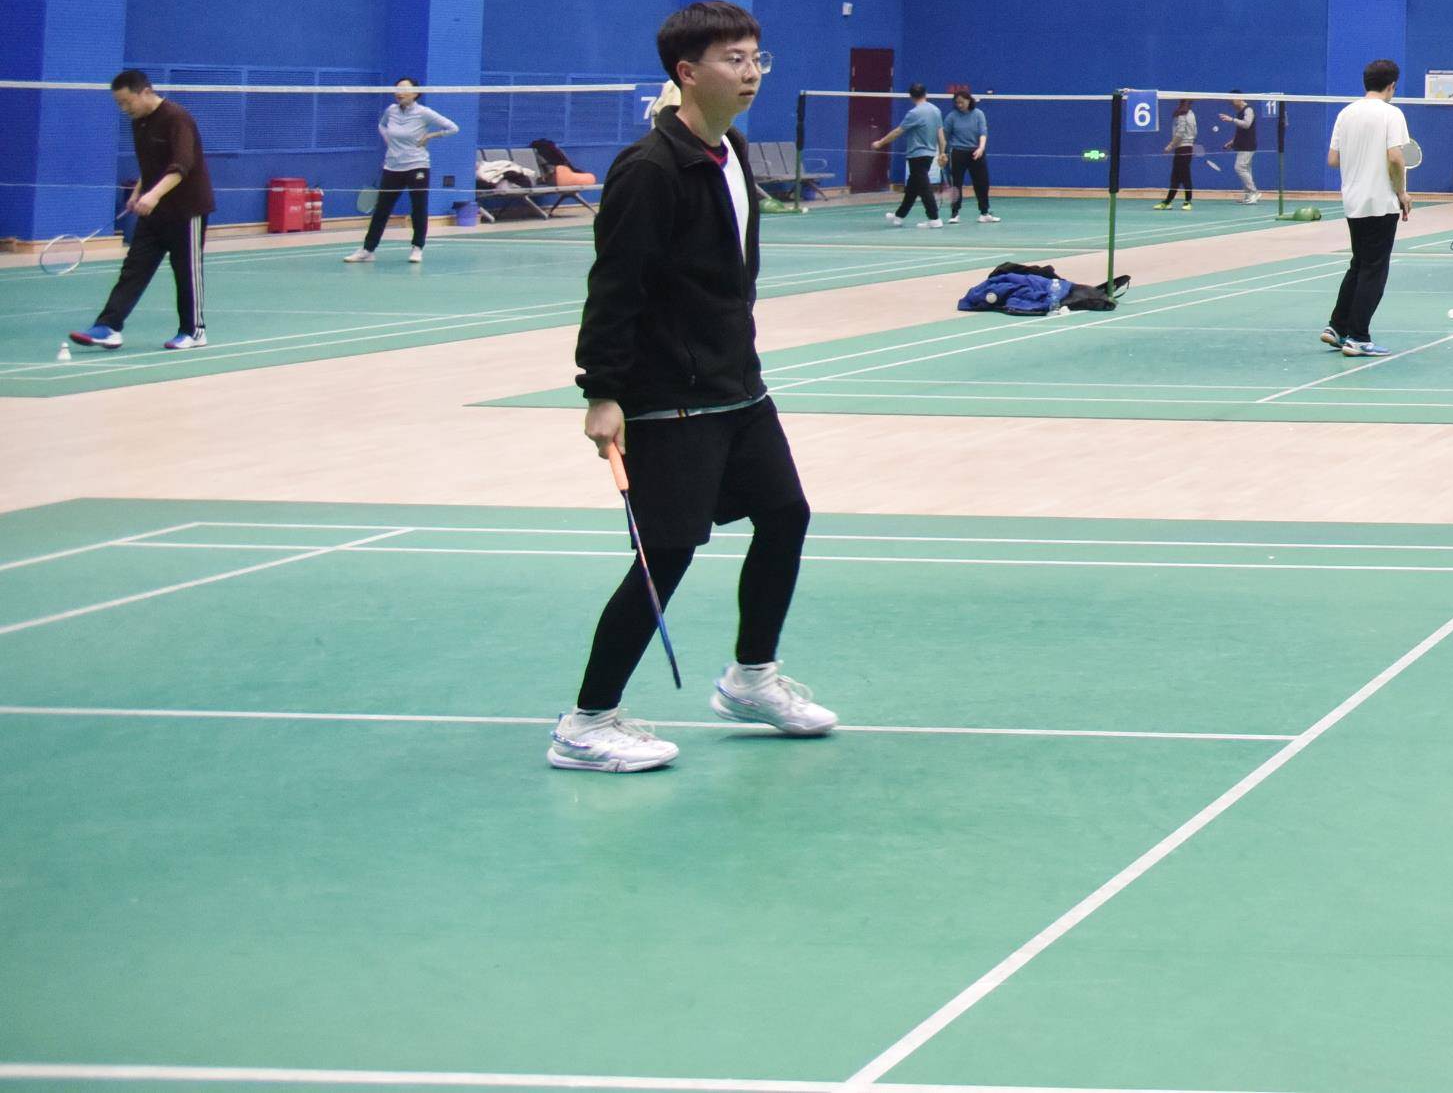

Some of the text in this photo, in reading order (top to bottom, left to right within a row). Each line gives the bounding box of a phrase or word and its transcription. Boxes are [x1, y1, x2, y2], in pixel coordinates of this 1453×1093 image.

[641, 96, 657, 119] 7
[1134, 102, 1150, 126] 6
[1265, 98, 1276, 114] 11
